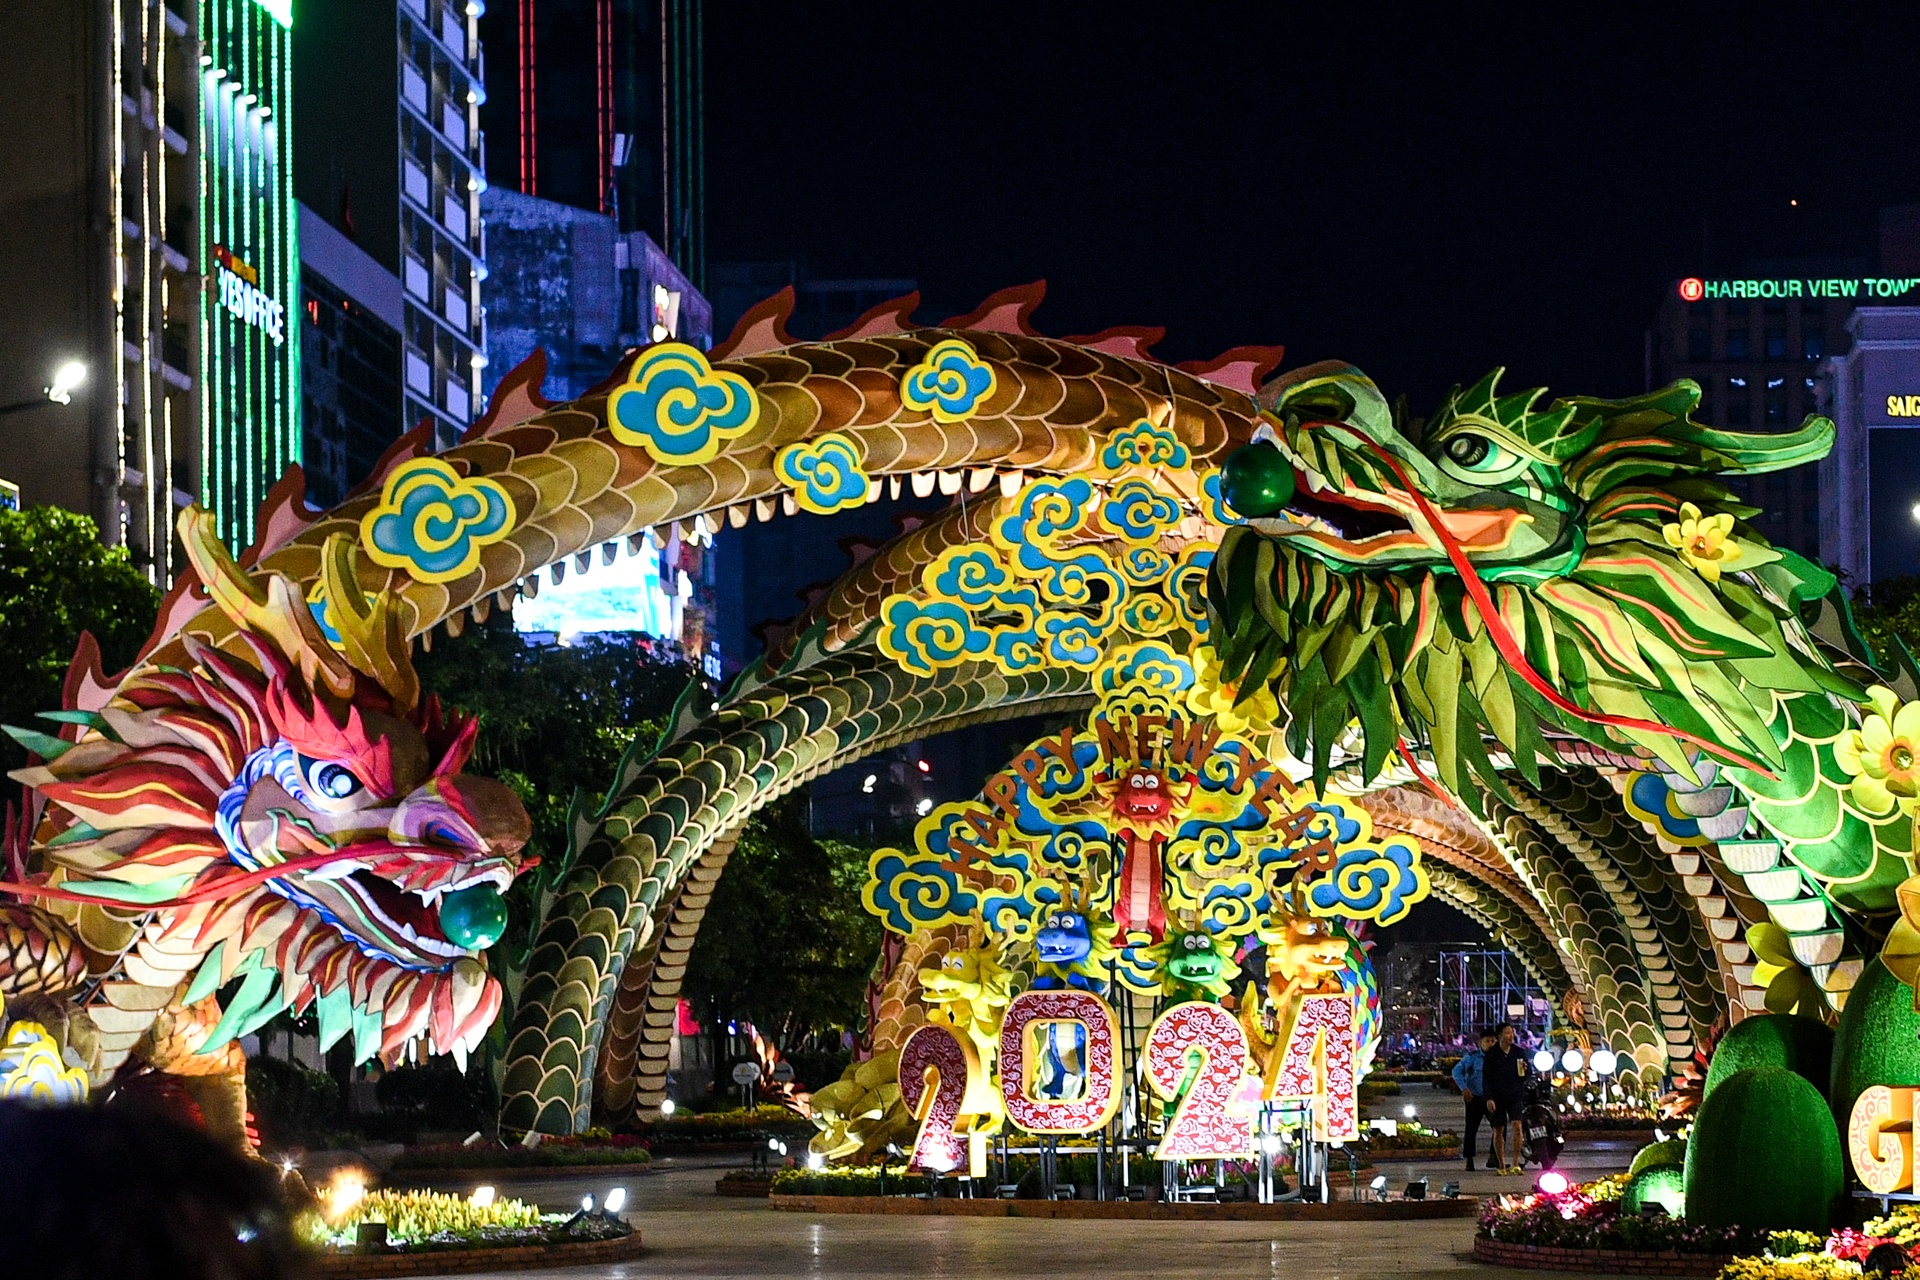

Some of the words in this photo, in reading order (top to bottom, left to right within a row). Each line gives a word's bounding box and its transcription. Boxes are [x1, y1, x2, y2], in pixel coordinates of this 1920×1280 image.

[1704, 279, 1802, 298] HARBOUR
[1808, 279, 1859, 297] VIEW
[940, 726, 1079, 878] HAPPY
[1095, 715, 1221, 770] NEW
[1231, 745, 1338, 877] YEAR
[898, 989, 1360, 1179] 2024
